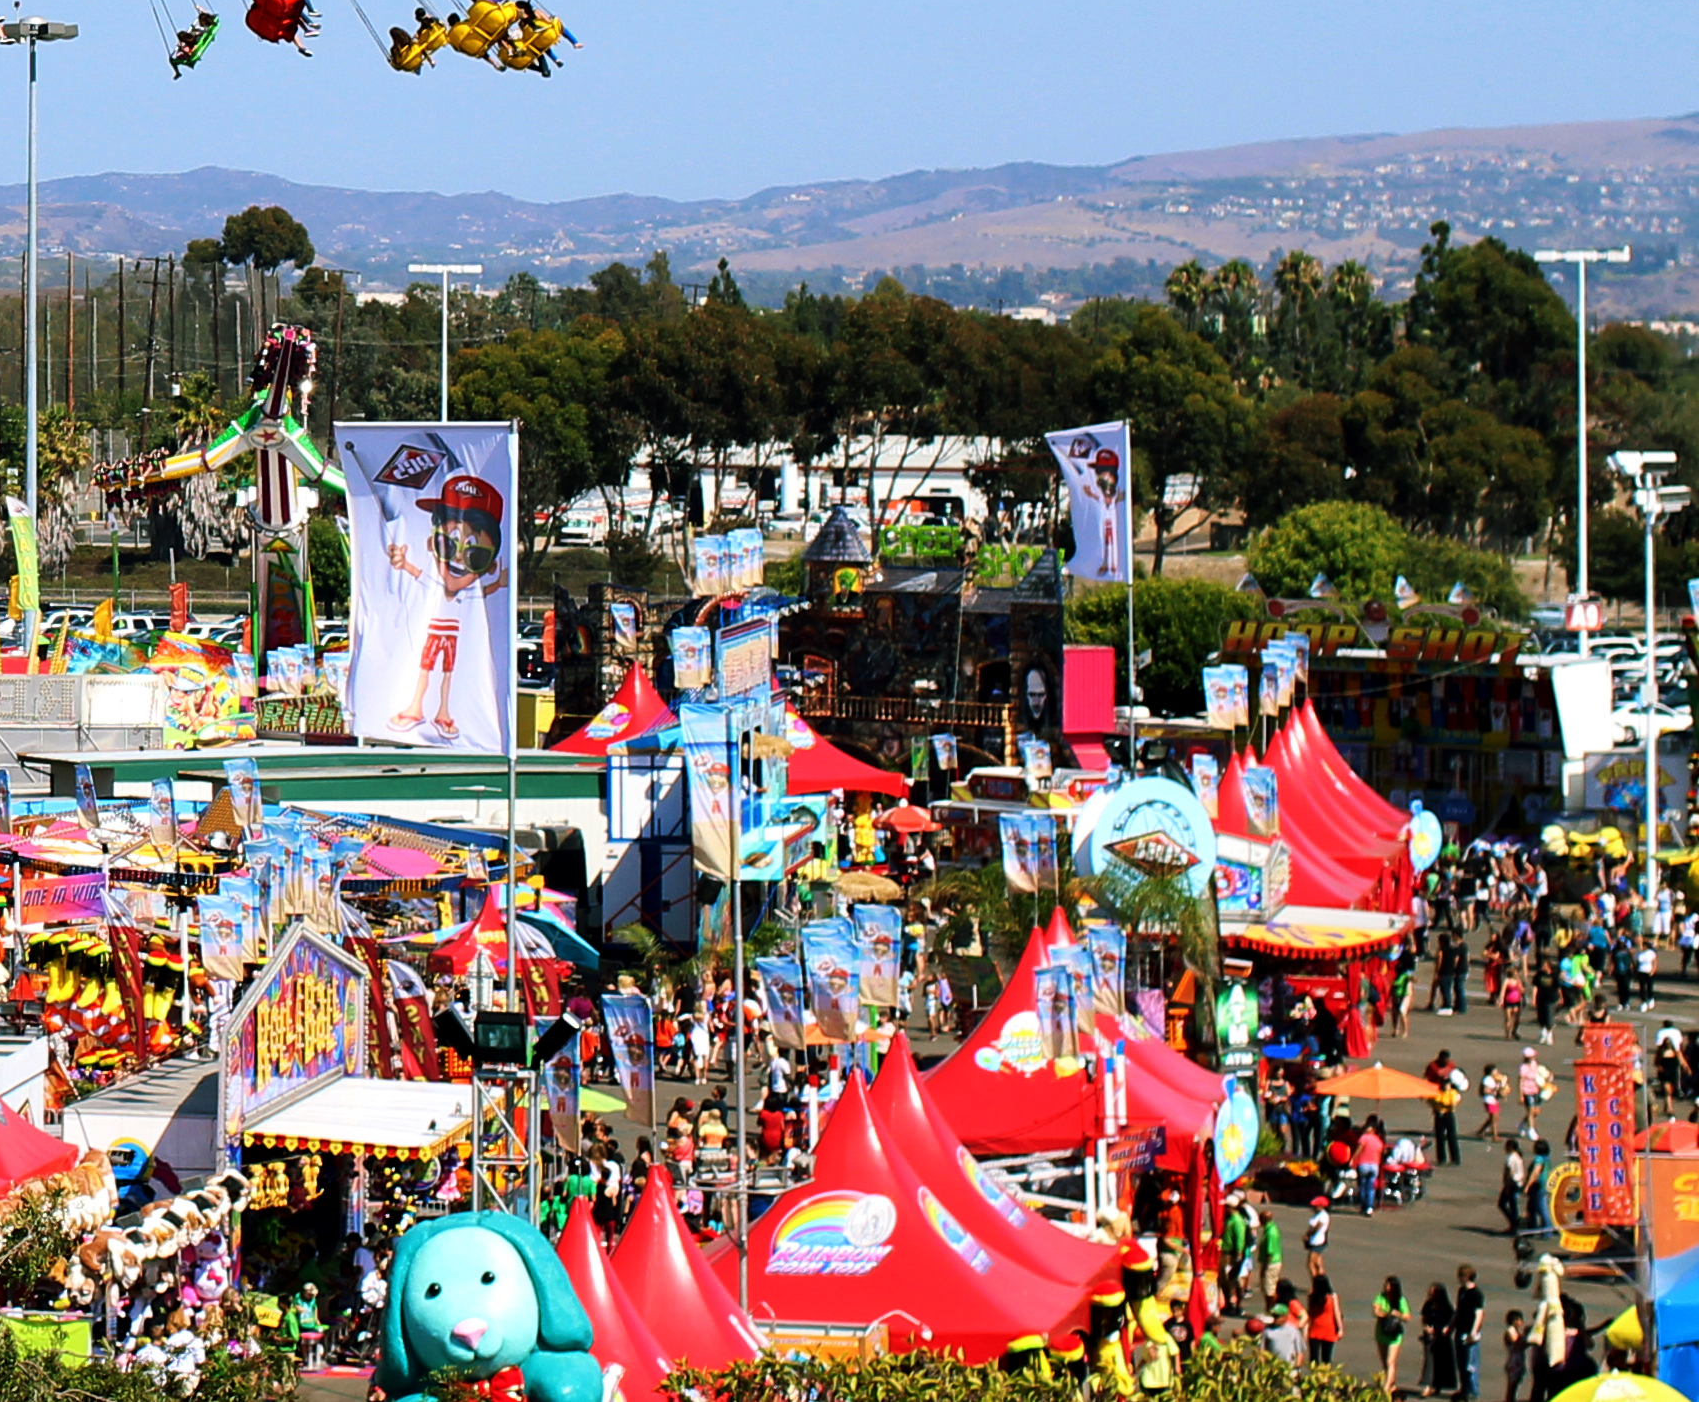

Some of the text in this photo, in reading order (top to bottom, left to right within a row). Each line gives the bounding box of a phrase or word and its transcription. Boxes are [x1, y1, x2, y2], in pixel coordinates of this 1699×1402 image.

[1570, 604, 1599, 627] A9
[1386, 627, 1527, 666] SHOT
[1227, 983, 1250, 1046] ATM
[1225, 1052, 1254, 1066] ATM
[1581, 1074, 1604, 1212] KETTLE
[1608, 1098, 1627, 1188] CORN
[769, 1240, 894, 1263] RAINBOW
